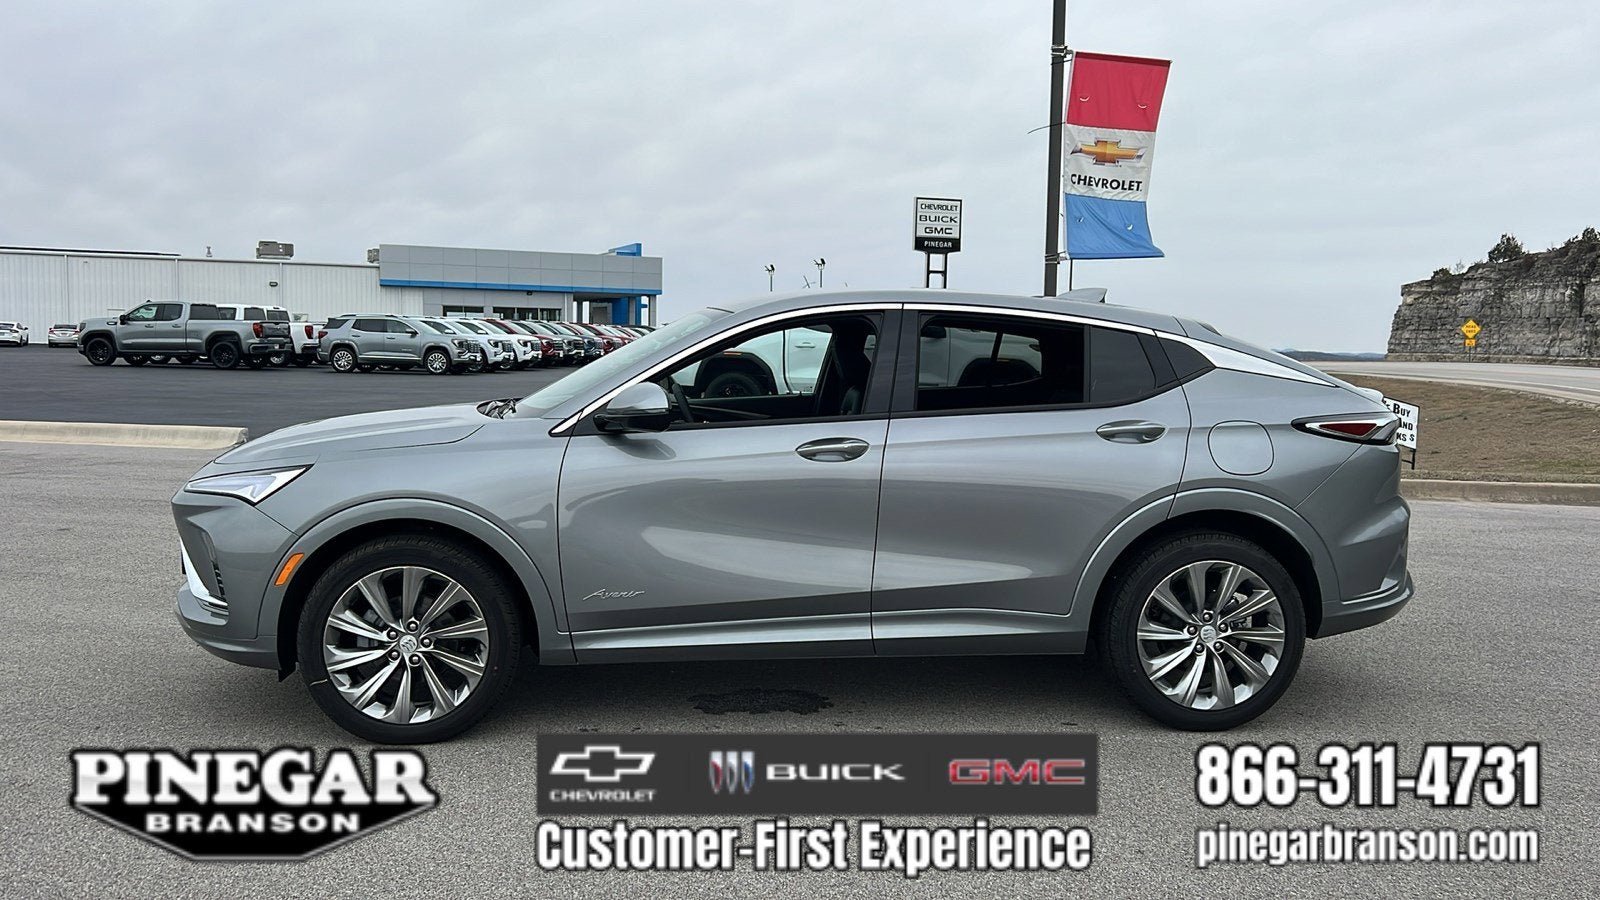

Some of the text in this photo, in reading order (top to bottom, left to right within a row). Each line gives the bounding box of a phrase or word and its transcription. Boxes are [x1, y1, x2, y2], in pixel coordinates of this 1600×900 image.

[1071, 174, 1142, 191] CHEVROLET
[920, 203, 958, 212] CHEVROLET
[919, 215, 958, 224] BUICK
[924, 227, 953, 235] GMC
[1393, 403, 1411, 417] BUY
